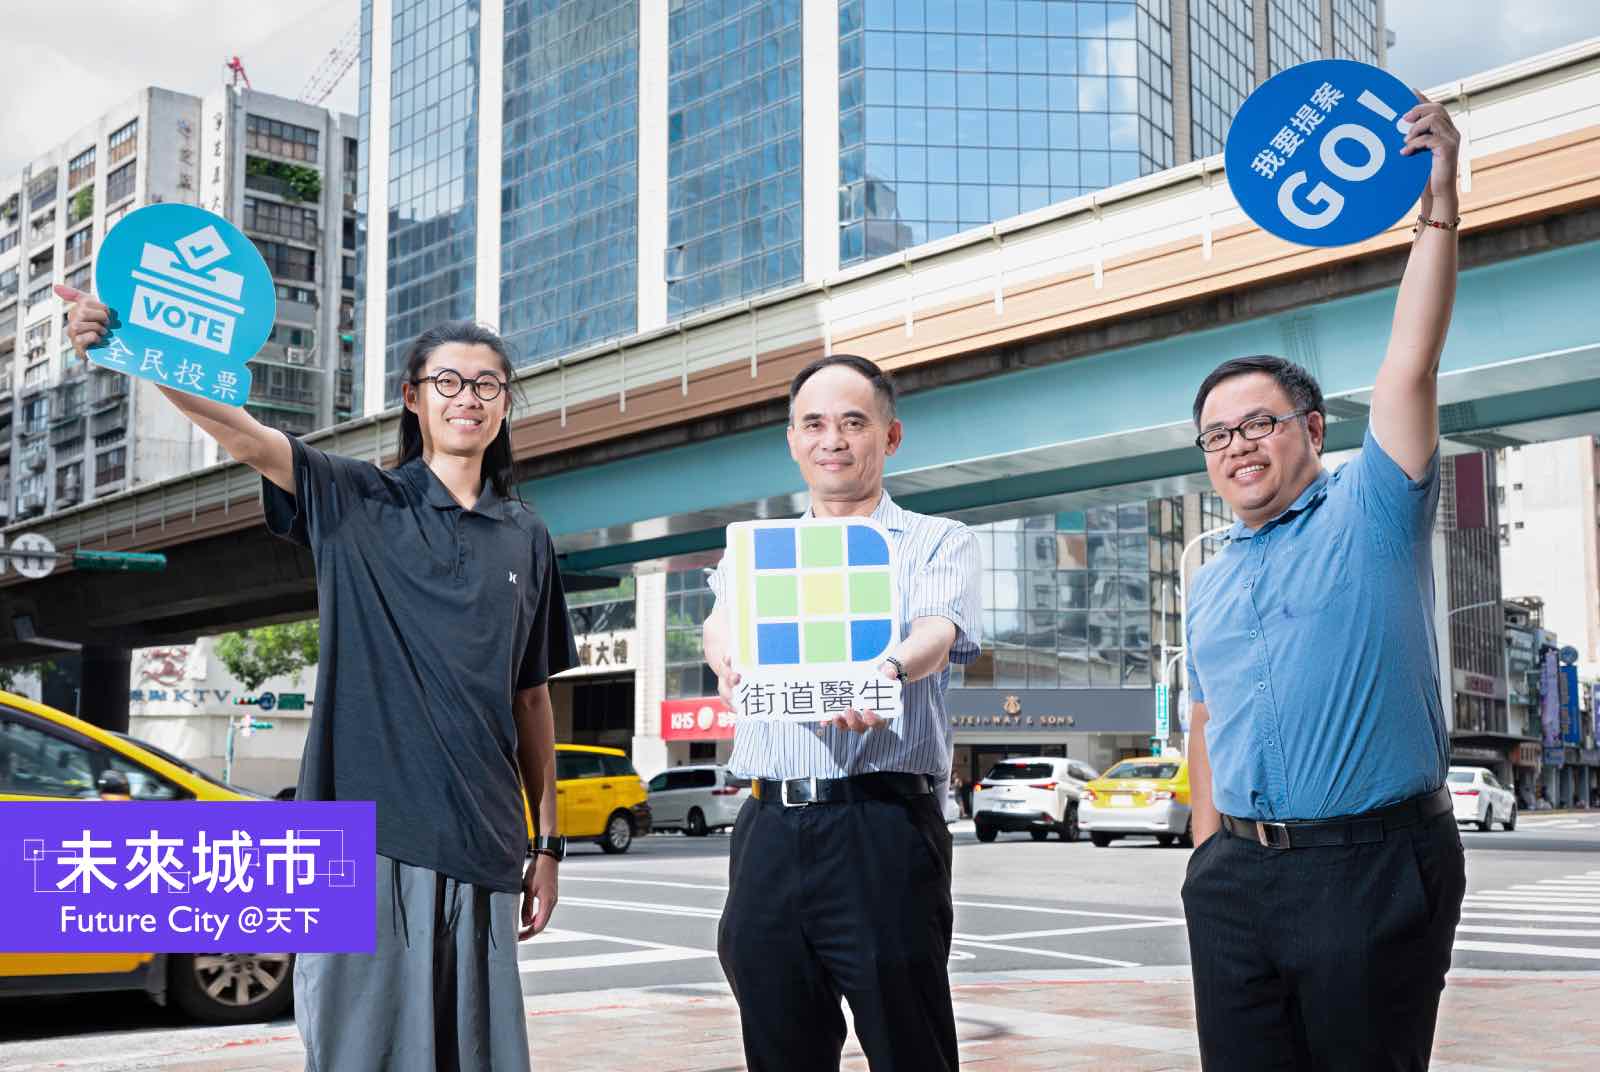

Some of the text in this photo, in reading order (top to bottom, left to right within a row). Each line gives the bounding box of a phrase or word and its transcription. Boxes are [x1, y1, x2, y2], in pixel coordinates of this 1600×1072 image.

[1250, 82, 1345, 180] 我要提案
[1277, 89, 1414, 230] GO!
[143, 295, 226, 344] VOTE
[103, 336, 241, 400] 全民投票
[174, 689, 231, 703] KTV
[740, 679, 895, 716] 街道醫生
[671, 712, 695, 730] KHS
[1040, 714, 1074, 726] SONS
